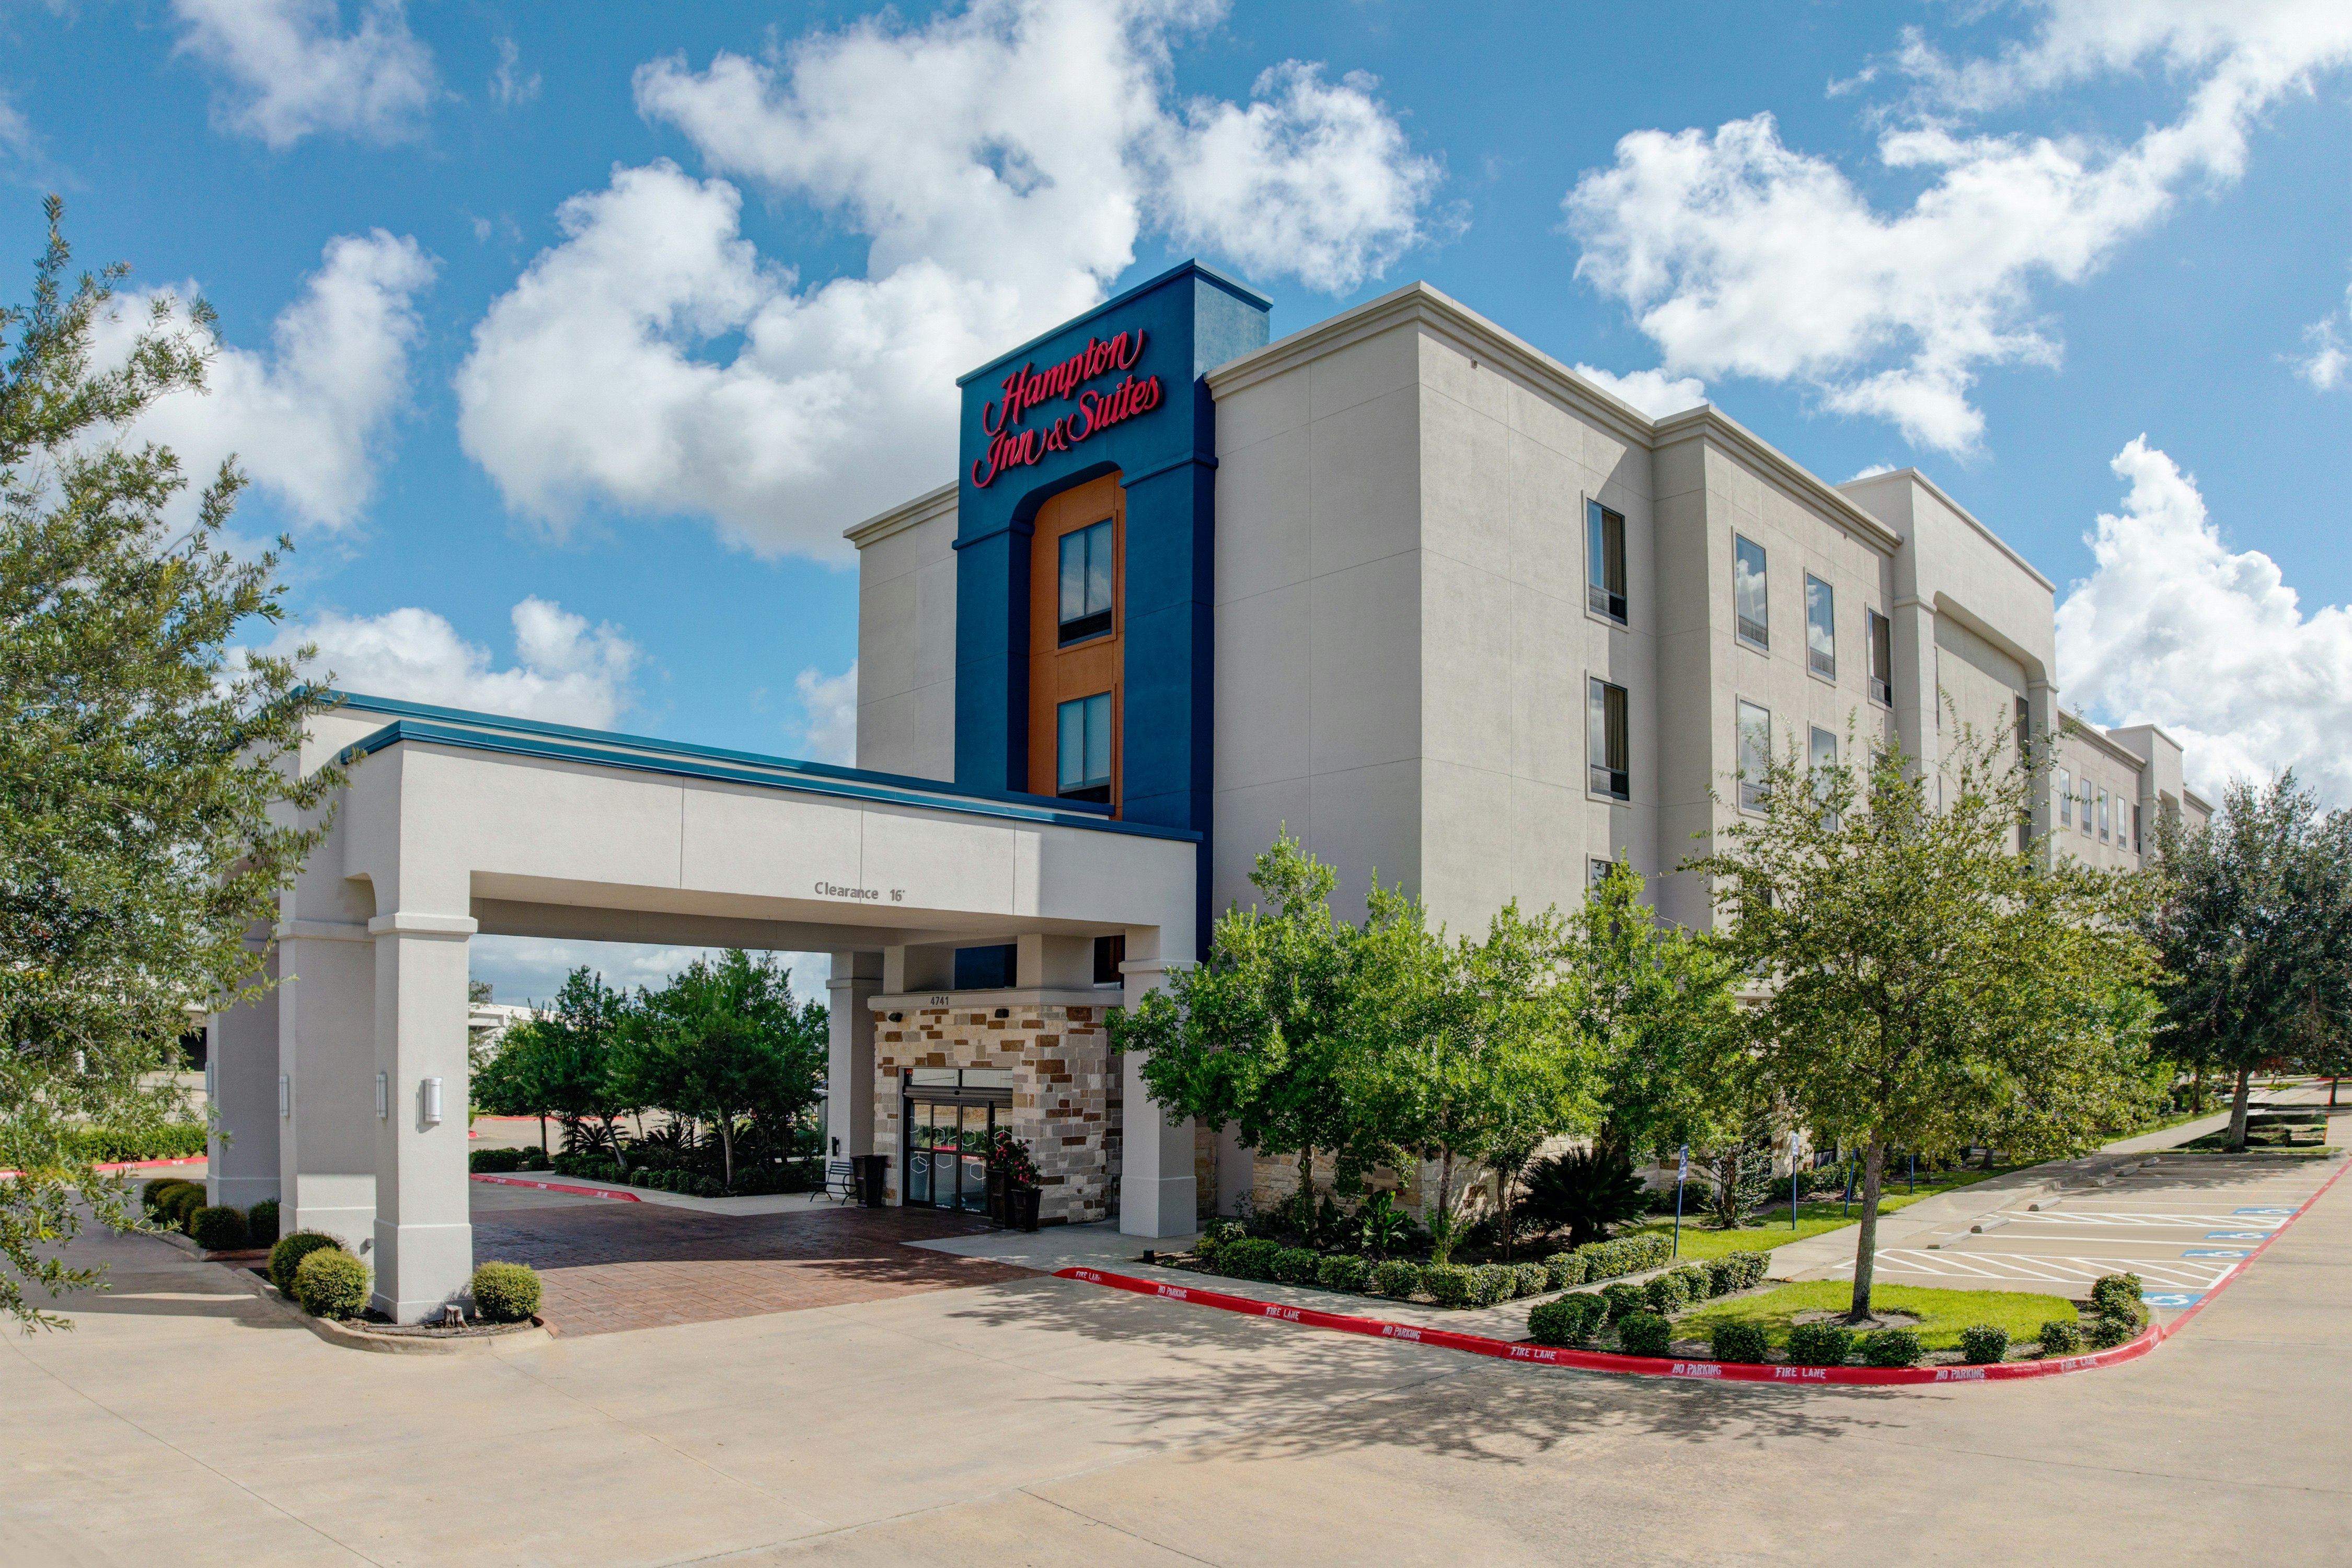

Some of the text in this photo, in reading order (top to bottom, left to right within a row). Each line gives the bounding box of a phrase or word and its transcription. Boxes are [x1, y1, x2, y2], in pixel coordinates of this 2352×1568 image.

[983, 328, 1145, 437] Hampton
[971, 374, 1162, 489] Inn & Suites
[814, 881, 879, 900] Clearance
[930, 996, 949, 1005] 4741
[1158, 1285, 1187, 1298] NO PARKING
[1266, 1307, 1300, 1320] FIRE LANE
[1382, 1325, 1421, 1340] NO PARKING
[1511, 1346, 1556, 1360] FIRE LANE
[1673, 1363, 1722, 1375] NO PARKING
[1776, 1367, 1827, 1379] FIRE LANE
[1936, 1368, 1985, 1380] NO PARKING
